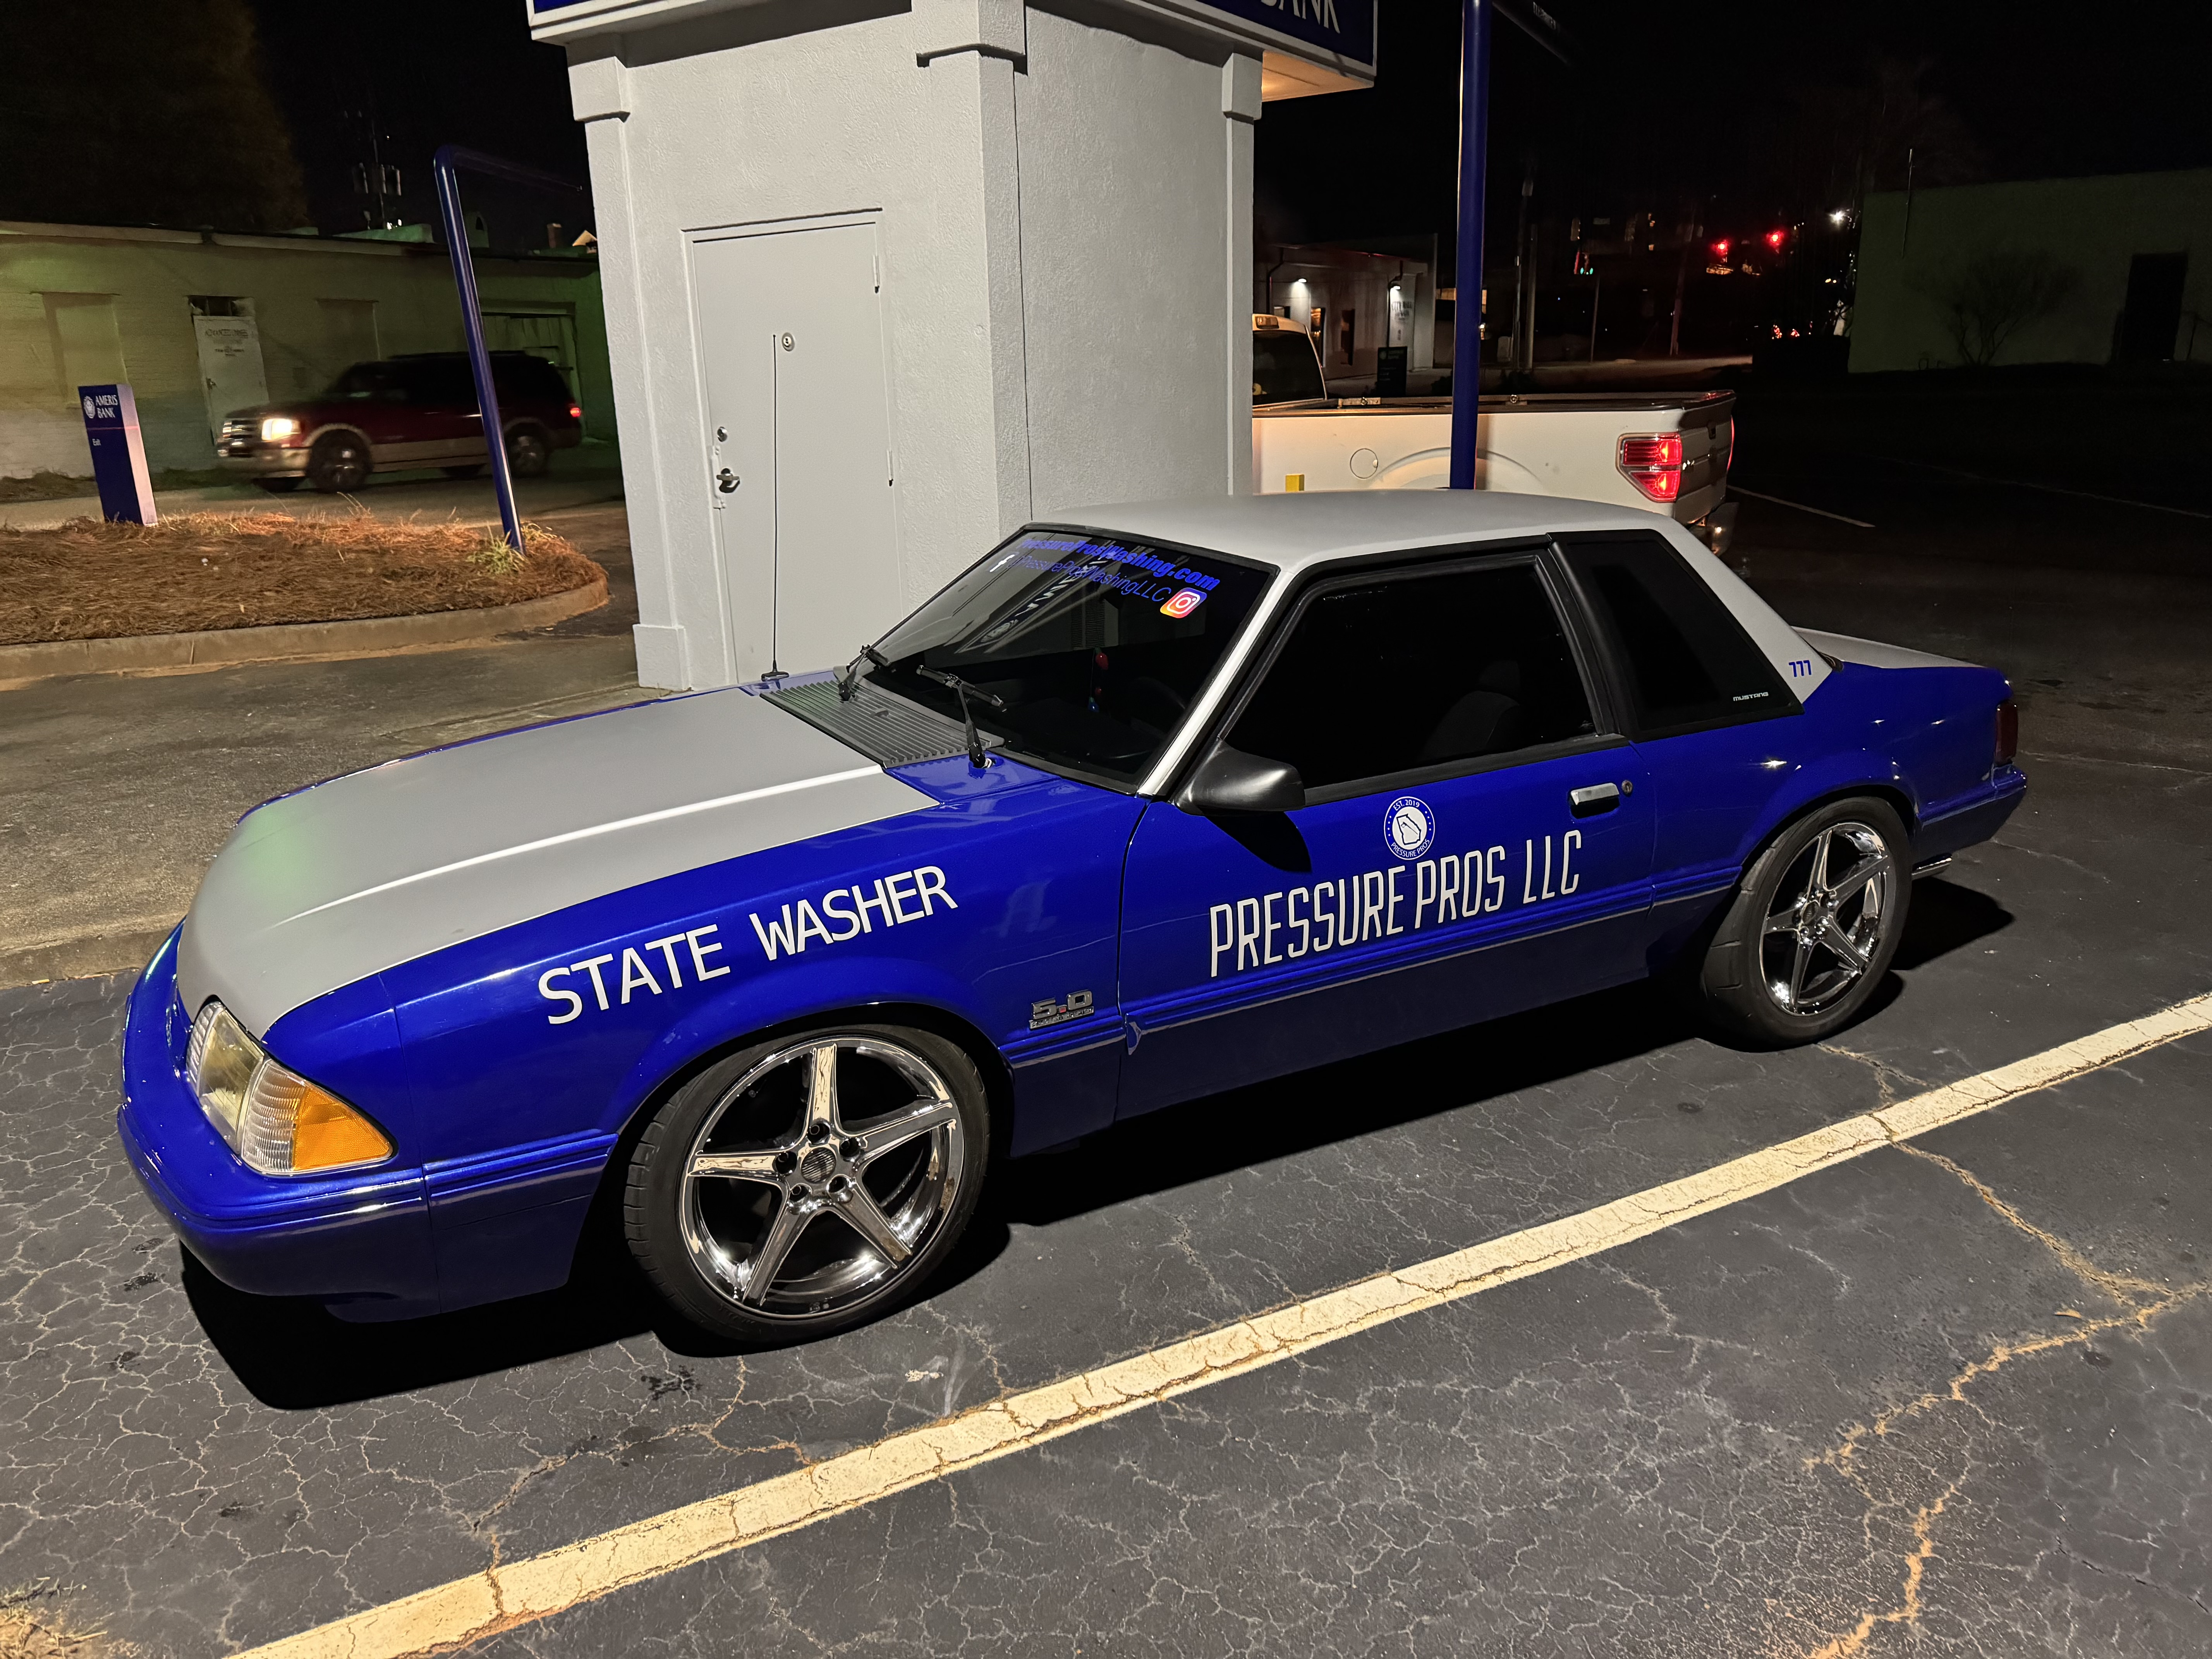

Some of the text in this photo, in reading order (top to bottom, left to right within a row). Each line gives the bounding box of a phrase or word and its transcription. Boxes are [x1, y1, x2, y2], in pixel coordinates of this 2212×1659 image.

[95, 395, 118, 406] AMERIS
[96, 407, 116, 418] BANK
[1788, 660, 1812, 677] 777
[1733, 692, 1769, 701] MUSTANG
[1393, 799, 1420, 811] EST. 2019
[1391, 838, 1430, 857] PRESSURE PROS
[1210, 830, 1581, 977] PRESSURE PROS LLC
[538, 866, 958, 1024] STATE WASHER
[1032, 989, 1092, 1020] 5.0
